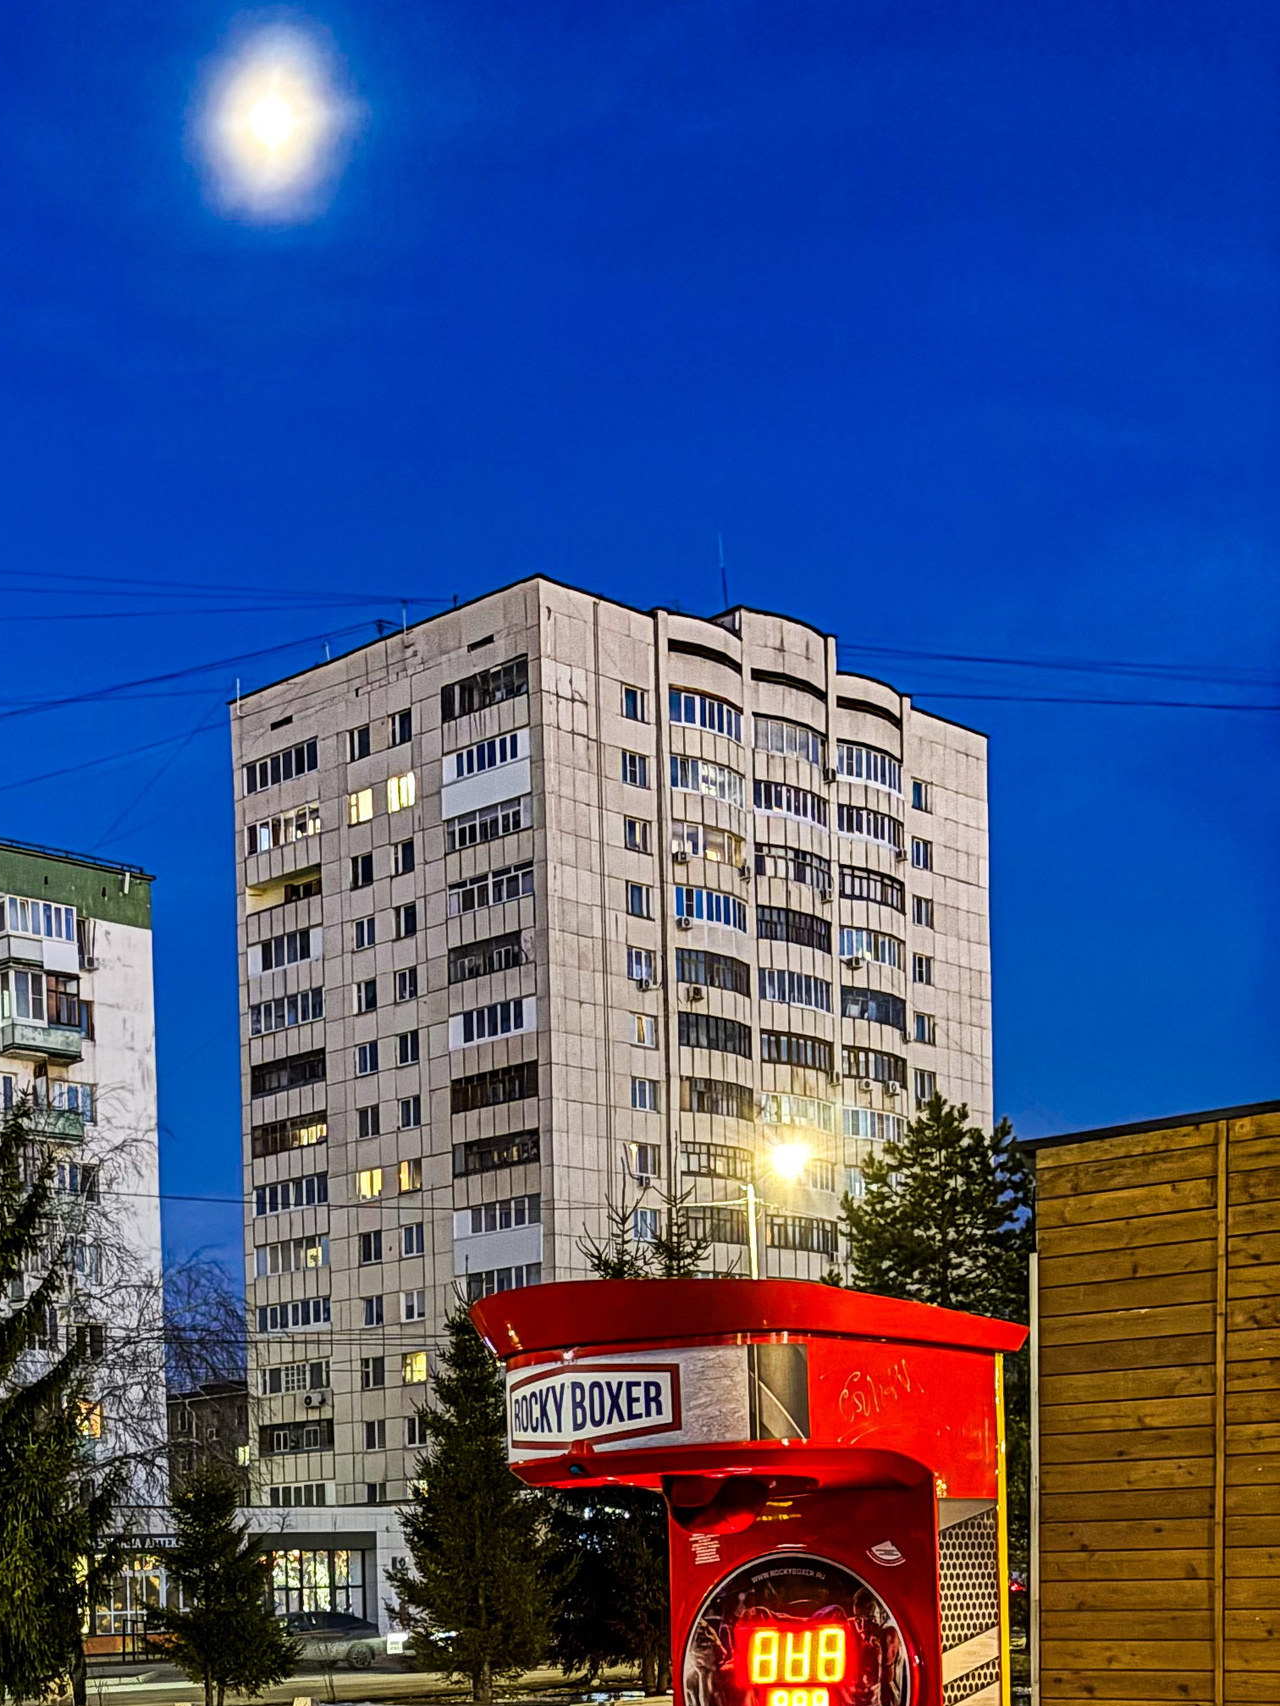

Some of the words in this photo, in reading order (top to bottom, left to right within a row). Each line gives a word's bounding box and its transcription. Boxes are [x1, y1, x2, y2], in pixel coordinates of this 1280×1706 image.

[514, 1382, 565, 1433] ROCKY
[571, 1381, 663, 1432] BOXER
[144, 1537, 181, 1548] АПТЕК
